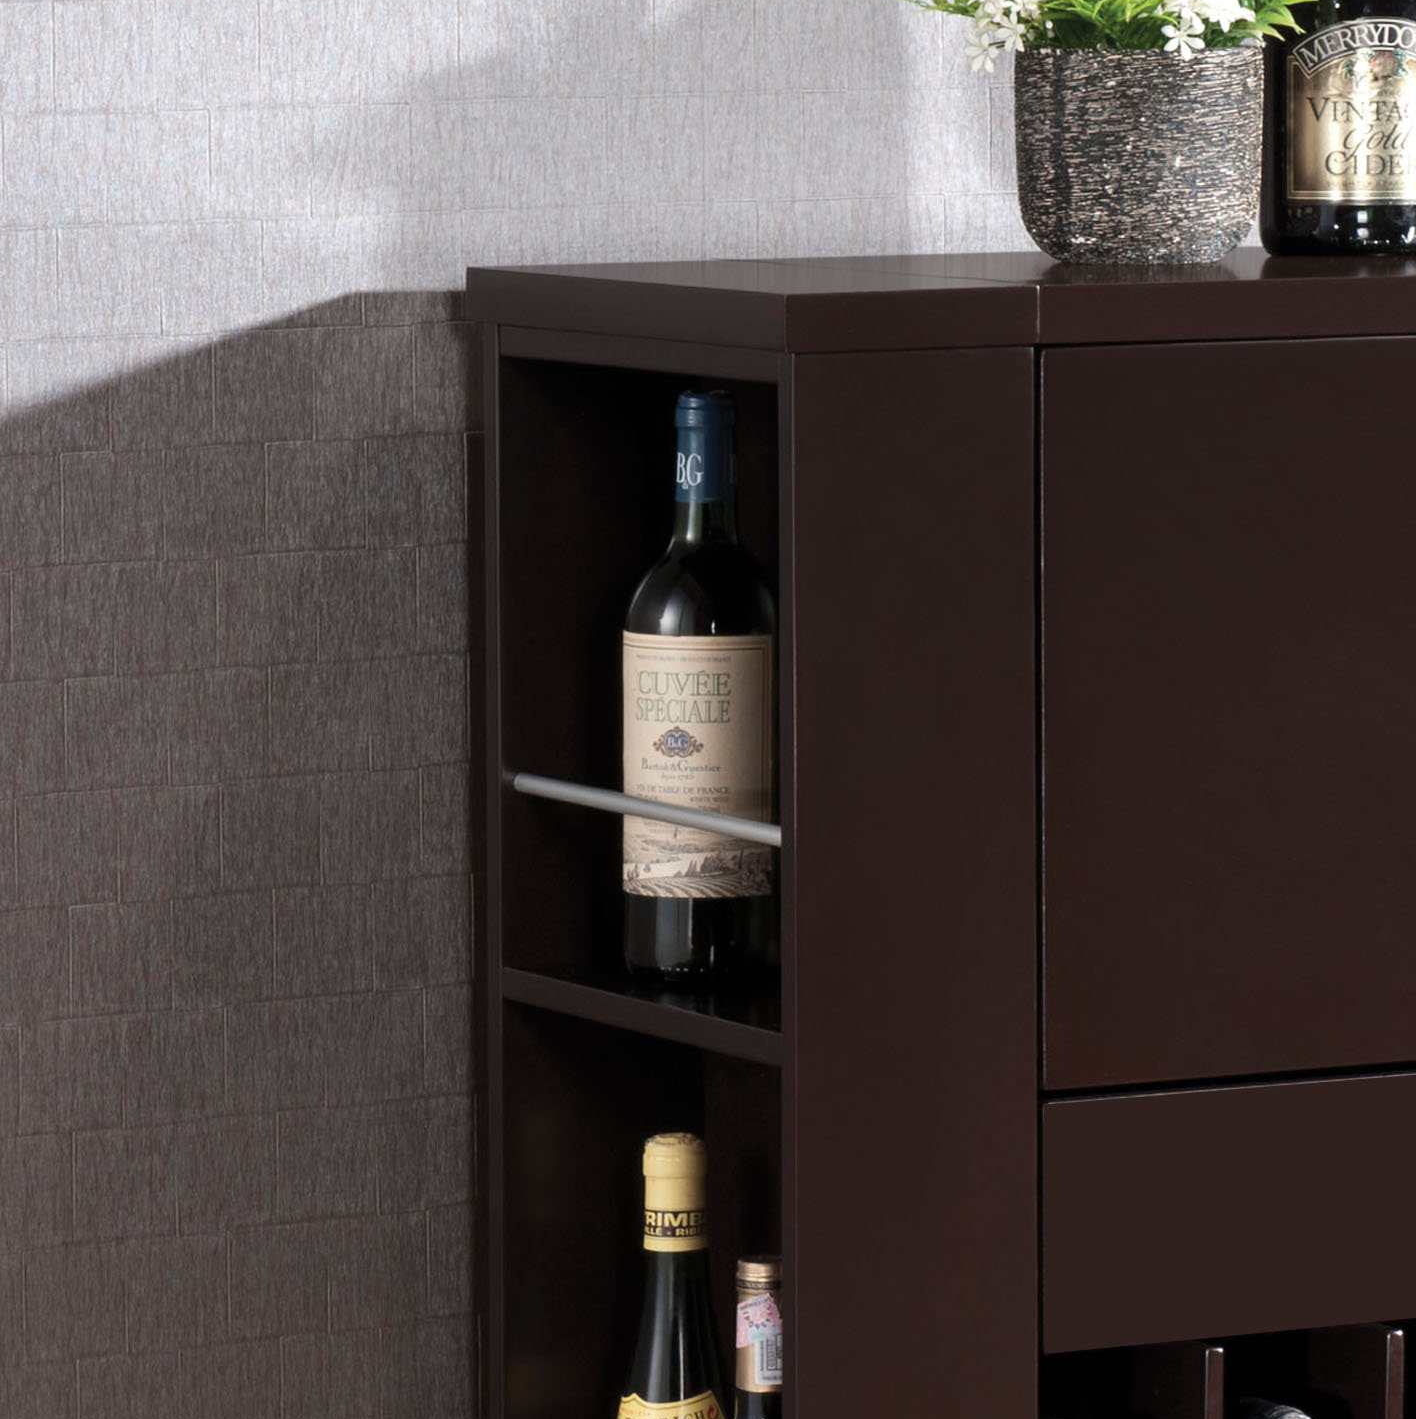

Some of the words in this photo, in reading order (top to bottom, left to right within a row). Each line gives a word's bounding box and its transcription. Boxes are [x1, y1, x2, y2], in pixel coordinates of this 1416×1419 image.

[638, 669, 732, 696] CUVÉE
[635, 696, 731, 723] SPÉCIALE
[645, 1211, 702, 1228] RIMB
